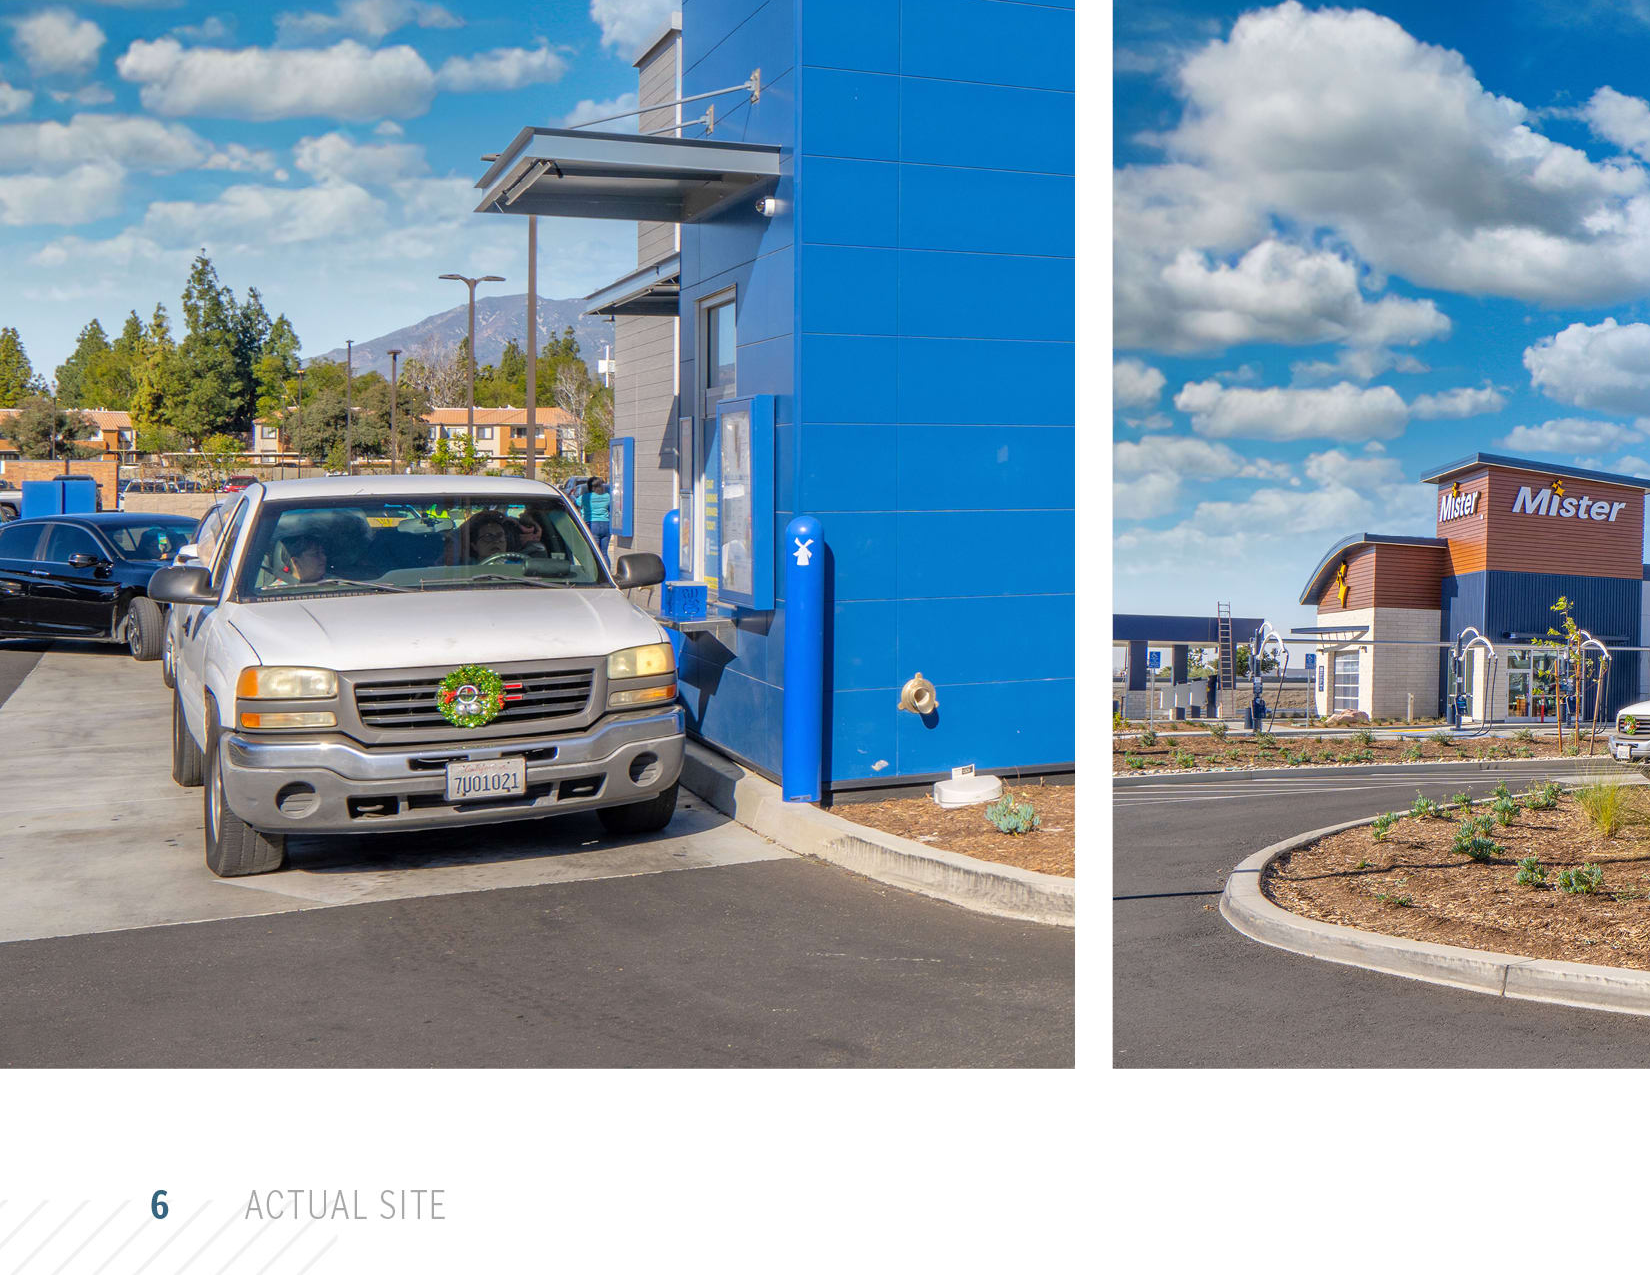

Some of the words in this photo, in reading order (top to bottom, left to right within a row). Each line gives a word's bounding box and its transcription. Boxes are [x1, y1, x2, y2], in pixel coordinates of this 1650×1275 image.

[1439, 491, 1479, 523] Mister
[1512, 485, 1626, 522] Mister
[455, 772, 518, 794] 7U01021
